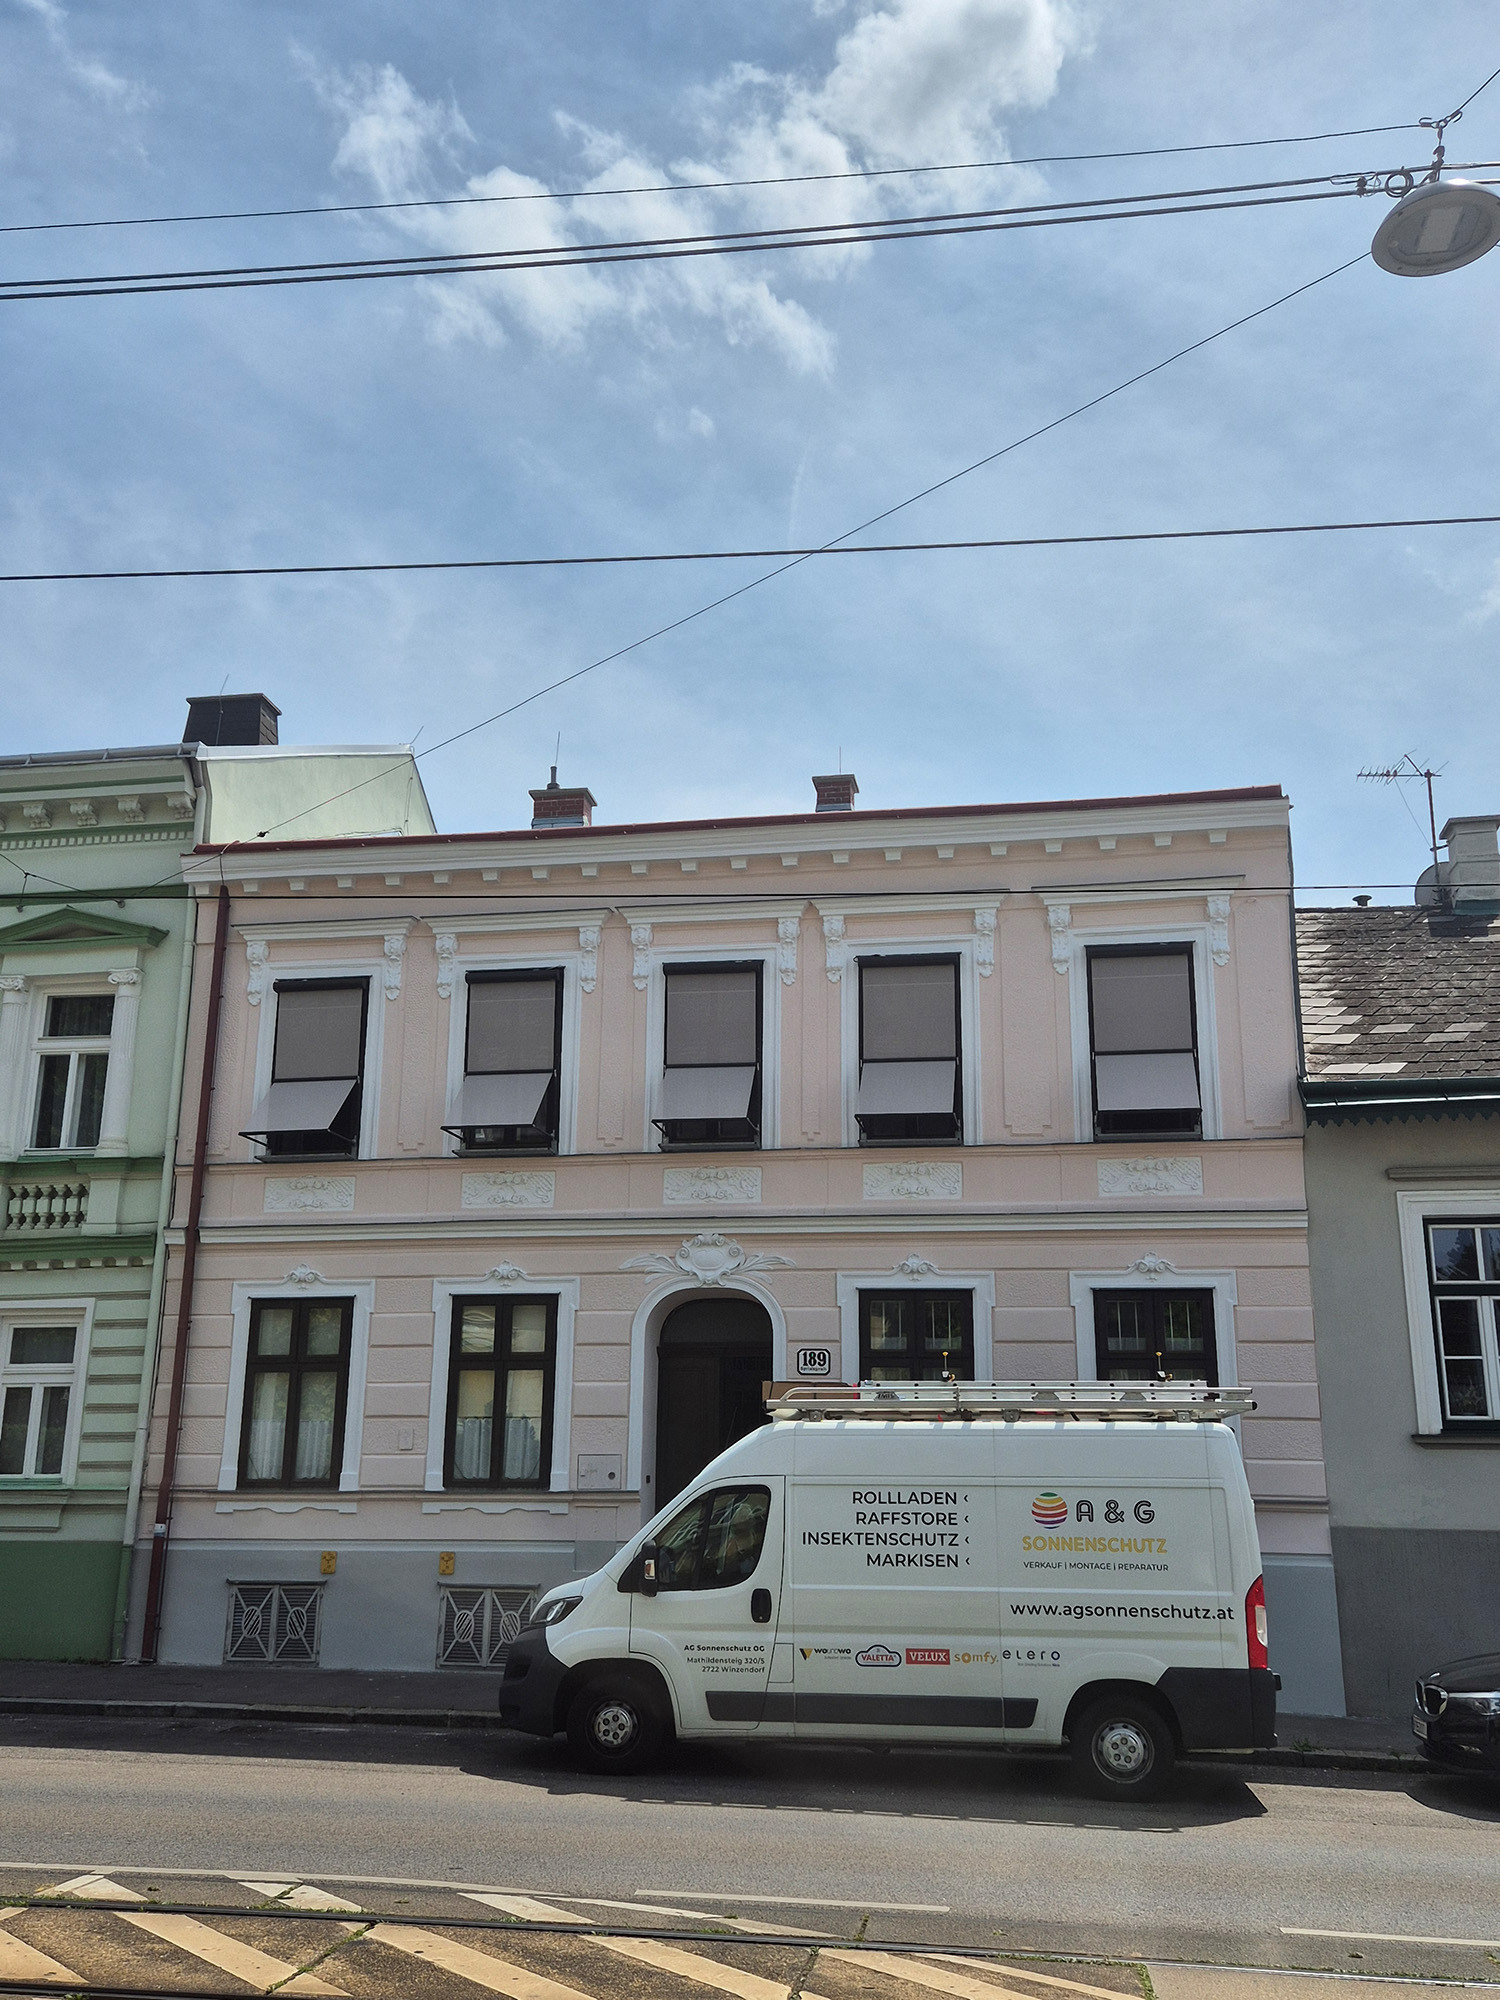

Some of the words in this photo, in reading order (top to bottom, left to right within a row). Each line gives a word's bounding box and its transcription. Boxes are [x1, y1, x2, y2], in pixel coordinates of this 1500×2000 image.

[802, 1351, 826, 1366] 189
[852, 1491, 957, 1505] ROLLLADEN
[856, 1511, 958, 1526] RAFFSTORE
[1075, 1499, 1094, 1523] A
[1104, 1499, 1125, 1524] &
[1133, 1500, 1156, 1524] G
[802, 1531, 960, 1547] INSEKTENSCHUTZ
[1021, 1535, 1168, 1554] SONNENSCHUTZ
[866, 1553, 959, 1568] MARKISEN
[1023, 1561, 1063, 1570] VERKAUF
[1069, 1562, 1112, 1571] MONTAGE
[1117, 1563, 1169, 1572] REPARATUR
[1010, 1603, 1235, 1621] www.agsonnenschutz.at
[683, 1644, 695, 1652] AG
[696, 1644, 752, 1652] Sonnenschutz
[1002, 1649, 1061, 1661] elero
[686, 1657, 743, 1666] Mathildensteig
[909, 1651, 947, 1662] VELUX
[721, 1666, 766, 1674] Winzendorf
